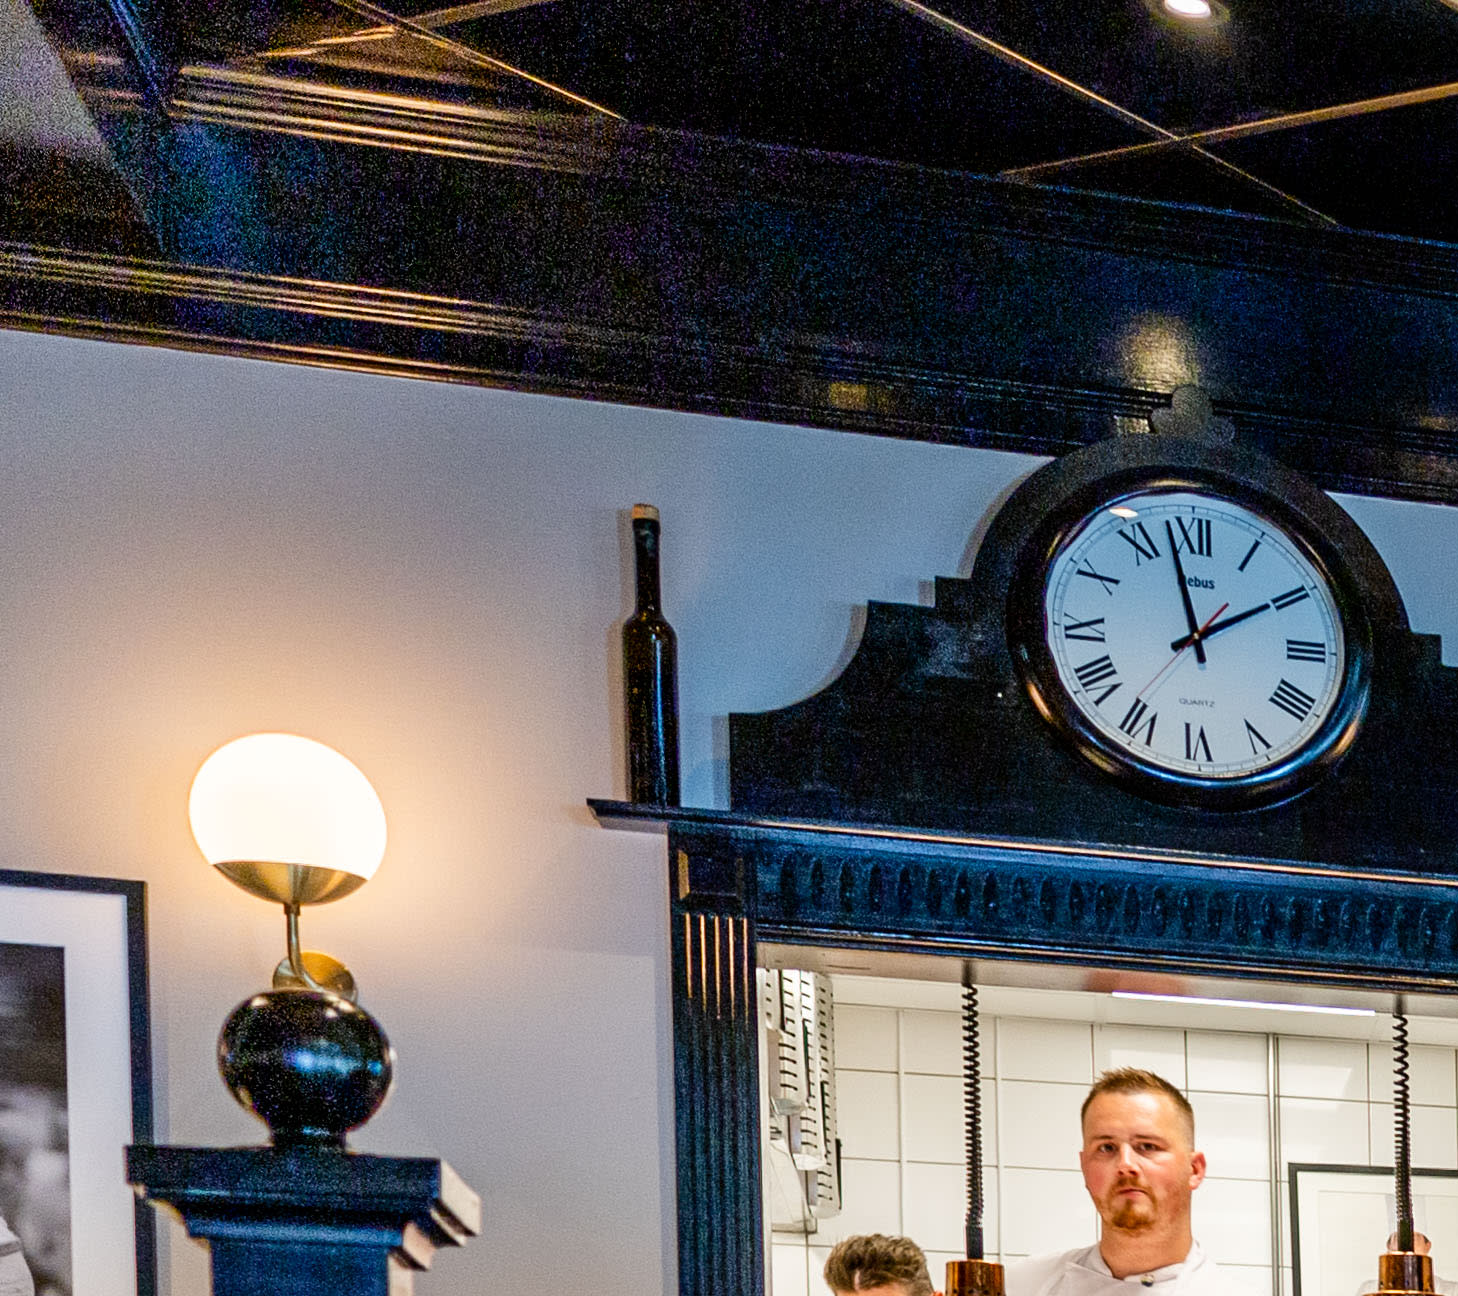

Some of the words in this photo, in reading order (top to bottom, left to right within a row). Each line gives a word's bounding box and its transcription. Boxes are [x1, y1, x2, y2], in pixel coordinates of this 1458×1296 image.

[1117, 522, 1160, 566] XI
[1176, 517, 1212, 557] XII
[1076, 559, 1120, 596] X
[1064, 613, 1105, 642] IX
[1075, 654, 1122, 706] VIII
[1119, 697, 1159, 746] VII
